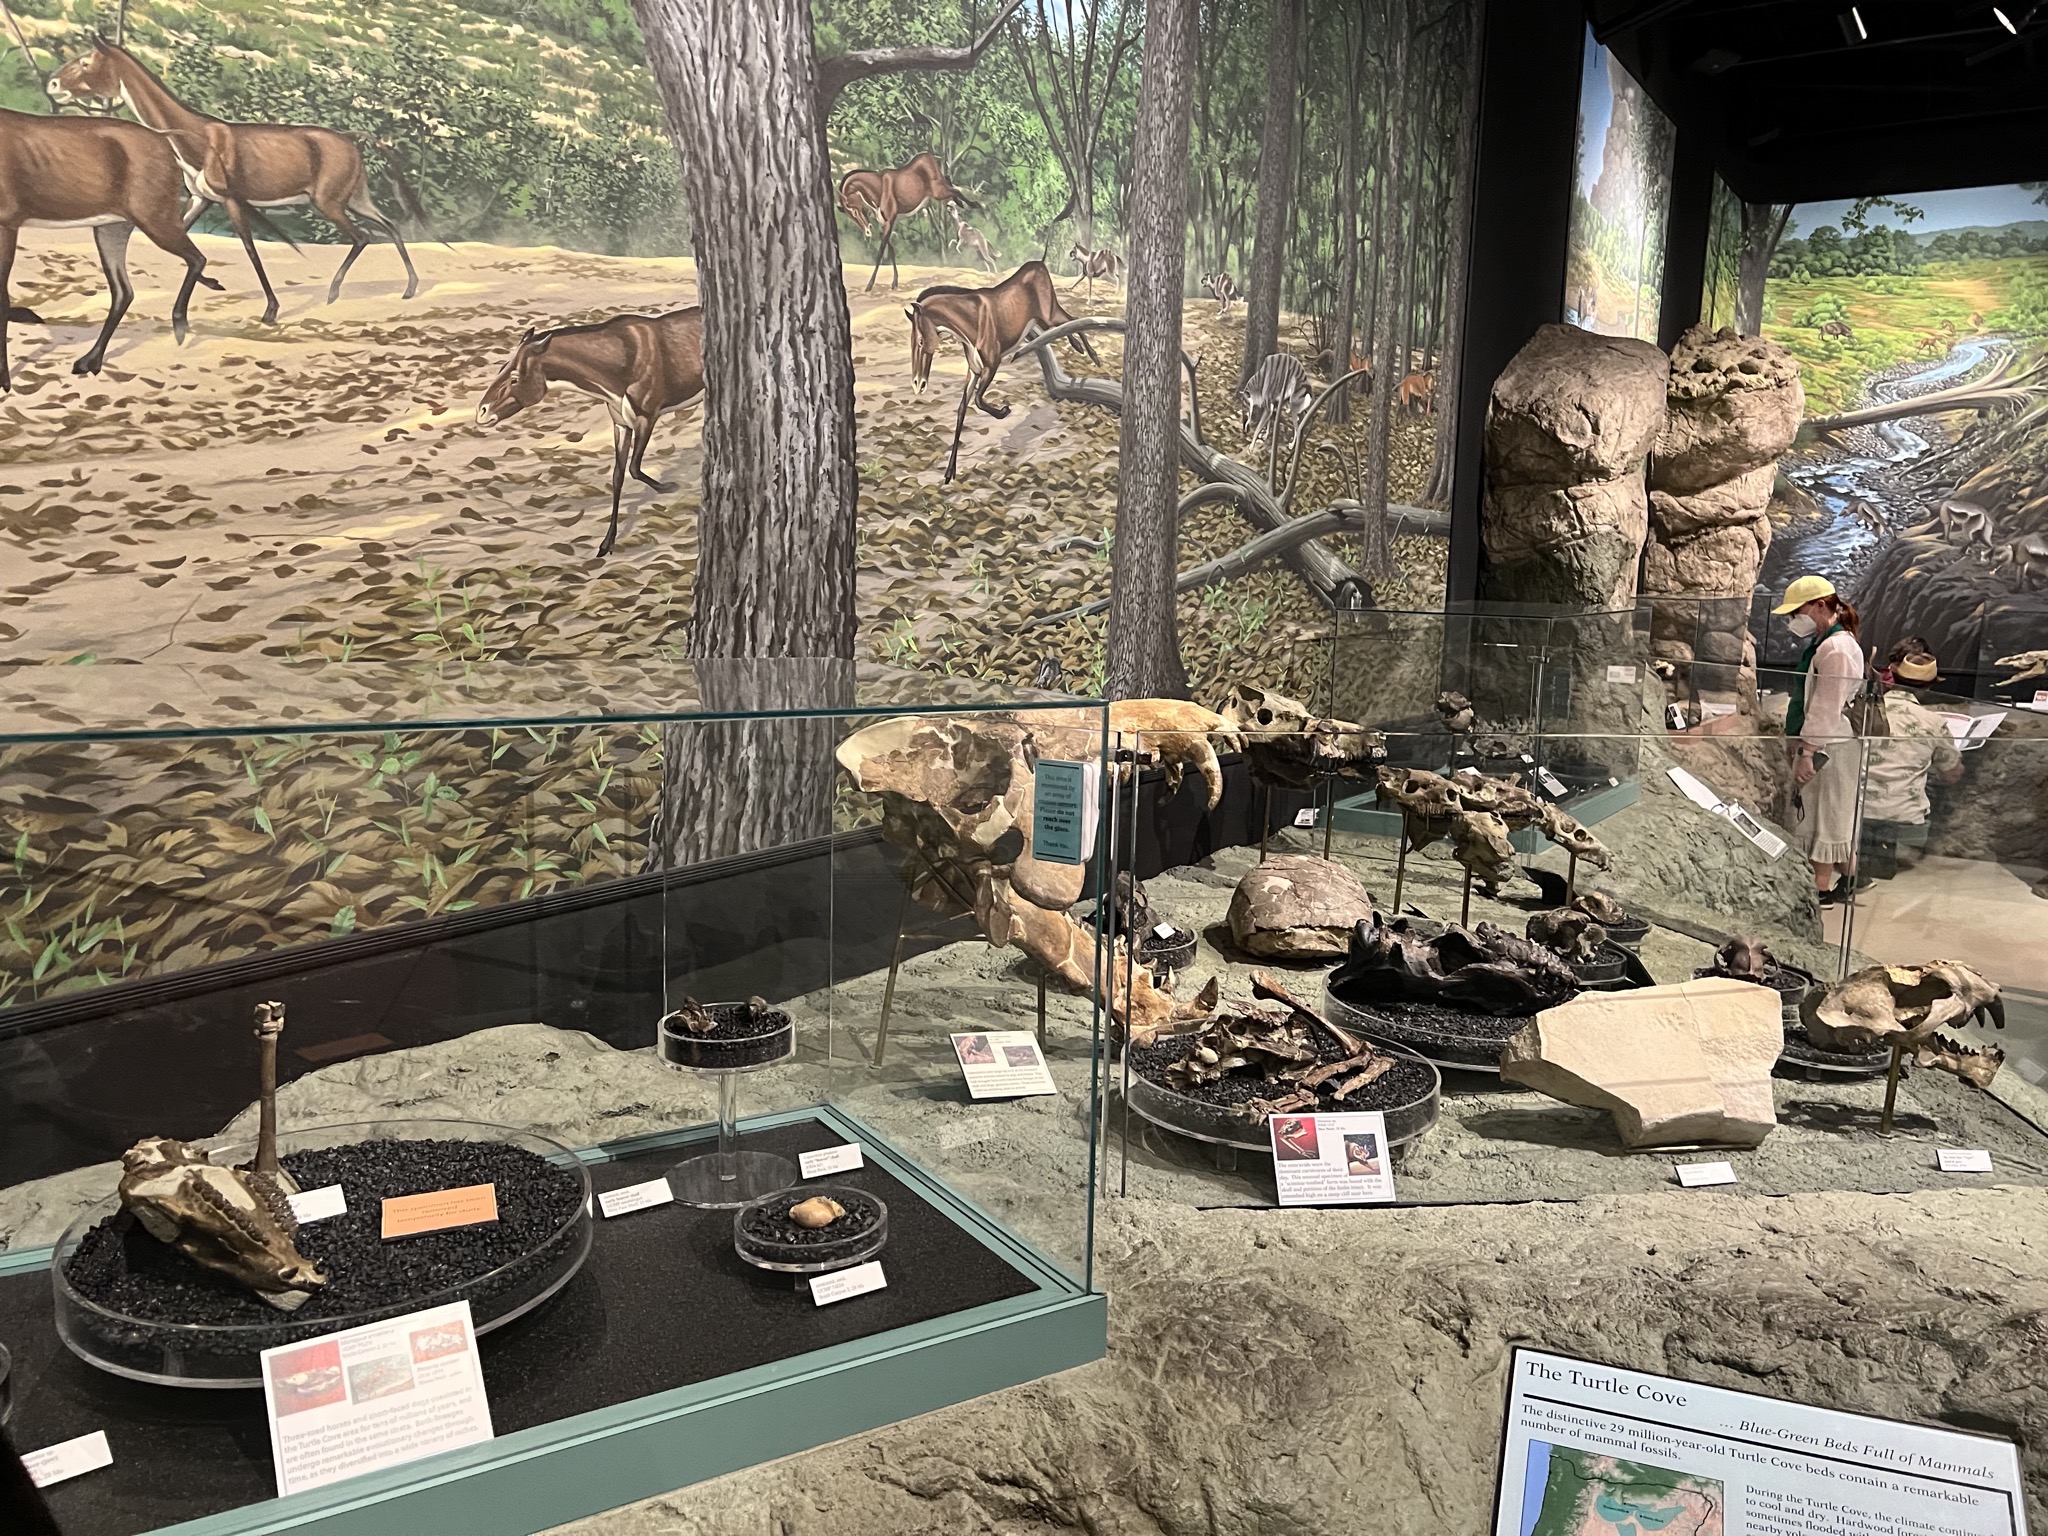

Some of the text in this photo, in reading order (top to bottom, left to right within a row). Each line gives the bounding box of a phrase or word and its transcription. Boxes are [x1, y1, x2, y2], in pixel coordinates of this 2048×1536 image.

[1526, 1361, 1687, 1407] The Turtle Cove
[1520, 1418, 1682, 1460] number of mammal fossils.
[1522, 1404, 1980, 1506] The distinctive 29 million-year-old Turtle Cove beds contain a remarkable
[1740, 1420, 1819, 1446] Blue-Green
[1824, 1437, 1858, 1453] Beds
[1863, 1445, 1895, 1460] Full
[1899, 1453, 1916, 1465] of
[1919, 1455, 1995, 1479] Mammals
[1745, 1497, 1756, 1506] to
[1759, 1501, 1781, 1512] cool
[1784, 1507, 1805, 1516] and
[1808, 1510, 1830, 1522] dry.
[1836, 1515, 1894, 1535] Hardwood
[1746, 1484, 1783, 1502] During
[1786, 1494, 1803, 1504] the
[1805, 1497, 1838, 1512] Turtle
[1841, 1505, 1871, 1519] Cove,
[1875, 1511, 1892, 1523] the
[1894, 1516, 1936, 1532] climate
[1746, 1510, 1803, 1527] sometimes
[1806, 1520, 1845, 1536] flooded
[1746, 1522, 1782, 1536] nearby
